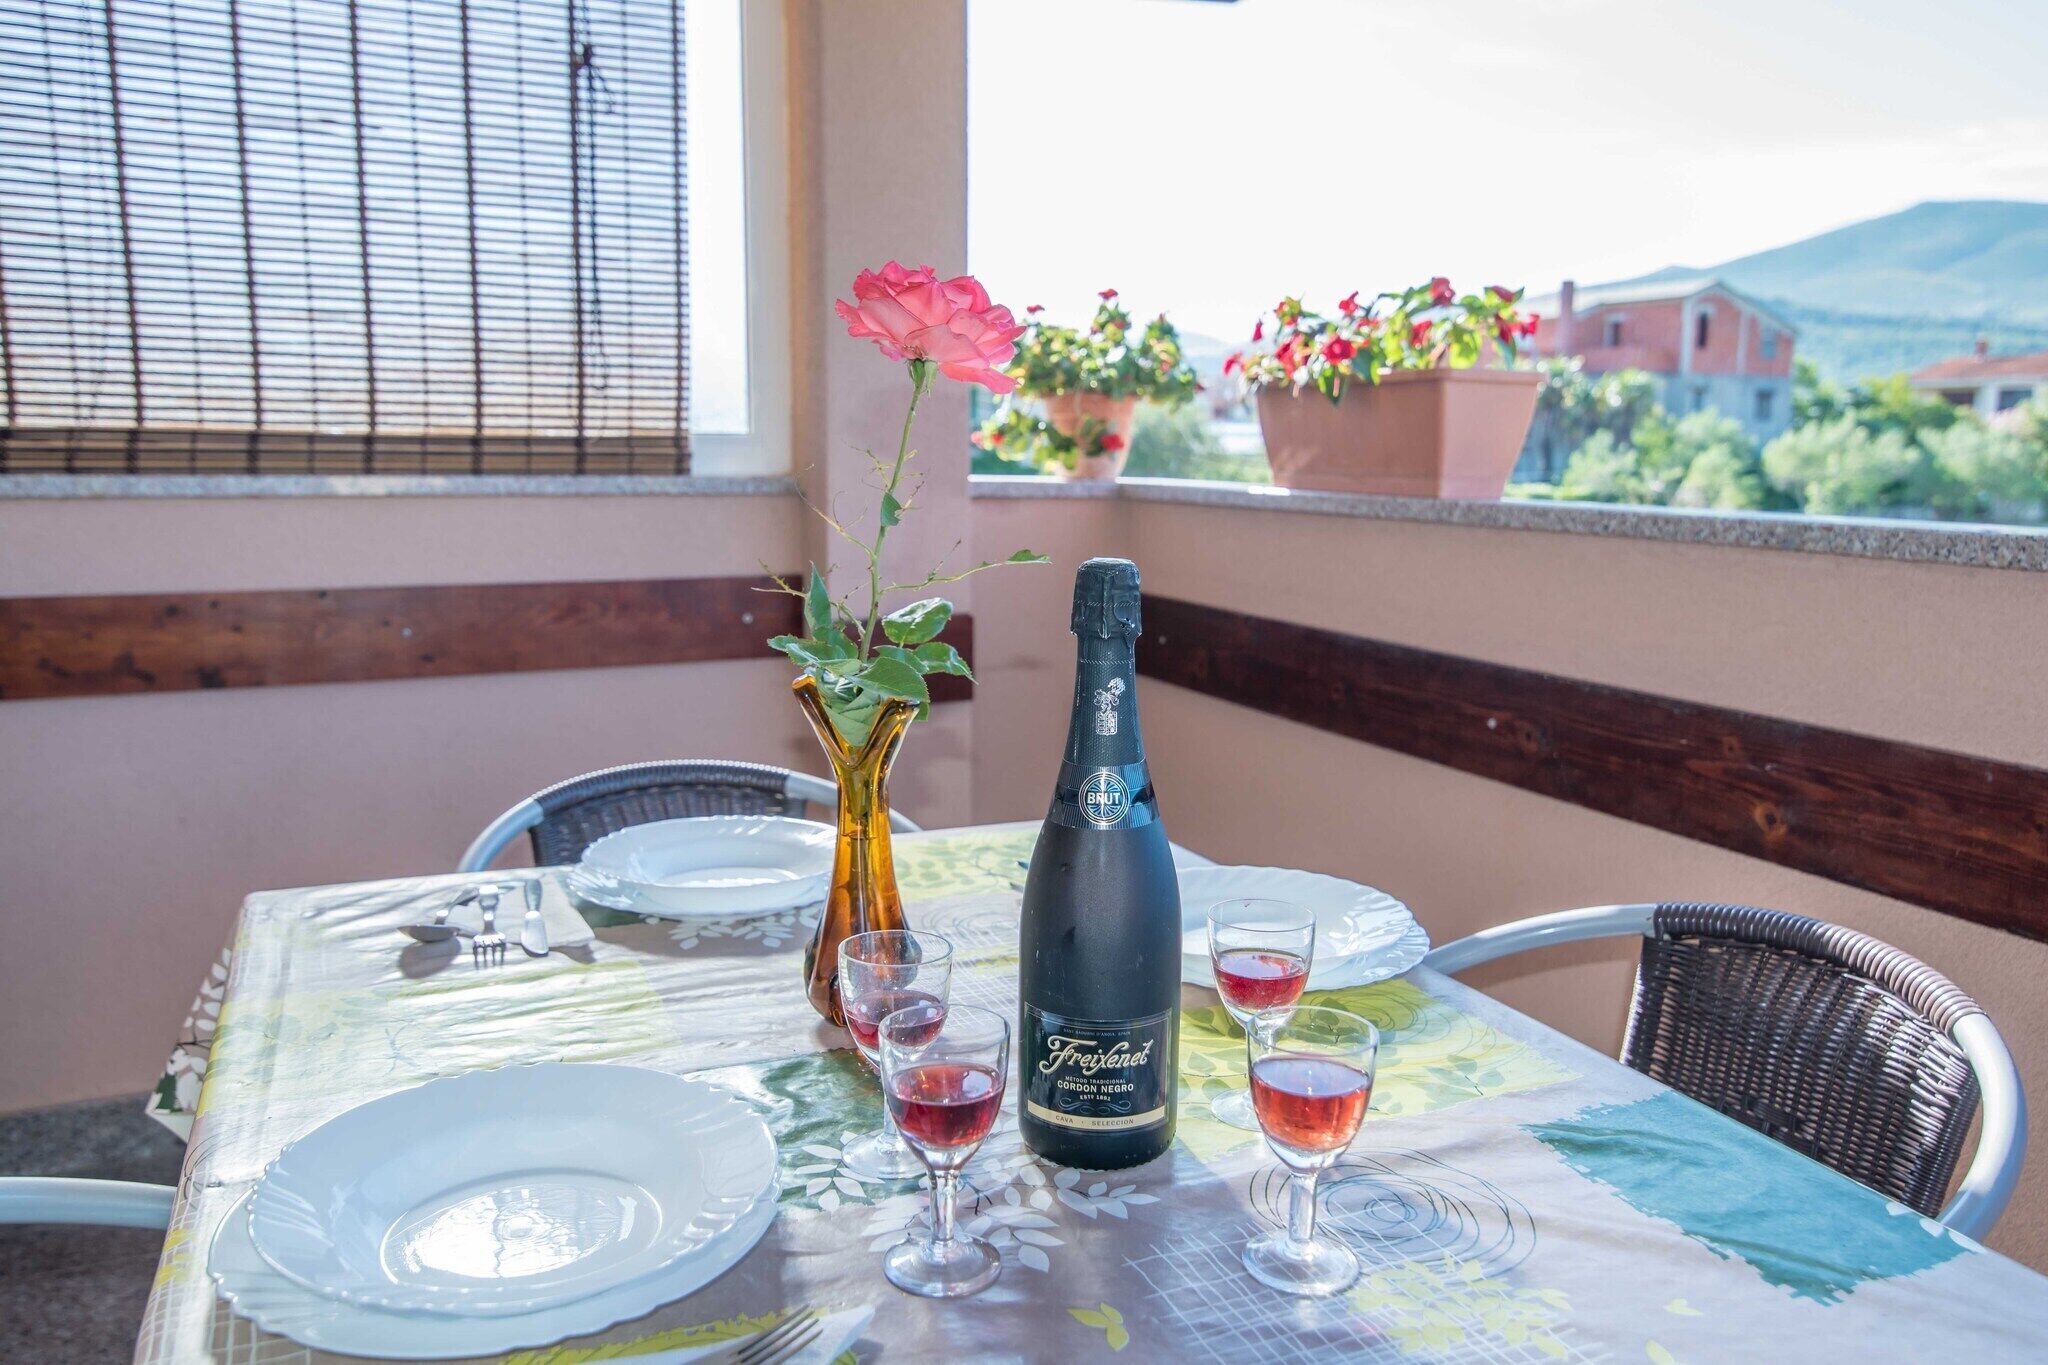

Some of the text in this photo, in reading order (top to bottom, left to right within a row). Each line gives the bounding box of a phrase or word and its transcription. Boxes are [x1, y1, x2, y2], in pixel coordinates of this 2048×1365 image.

[1087, 792, 1120, 804] BRUT
[1039, 1035, 1154, 1076] Freixenet
[1057, 1080, 1134, 1093] CORDON NEGRO
[1055, 1115, 1074, 1123] CAVA
